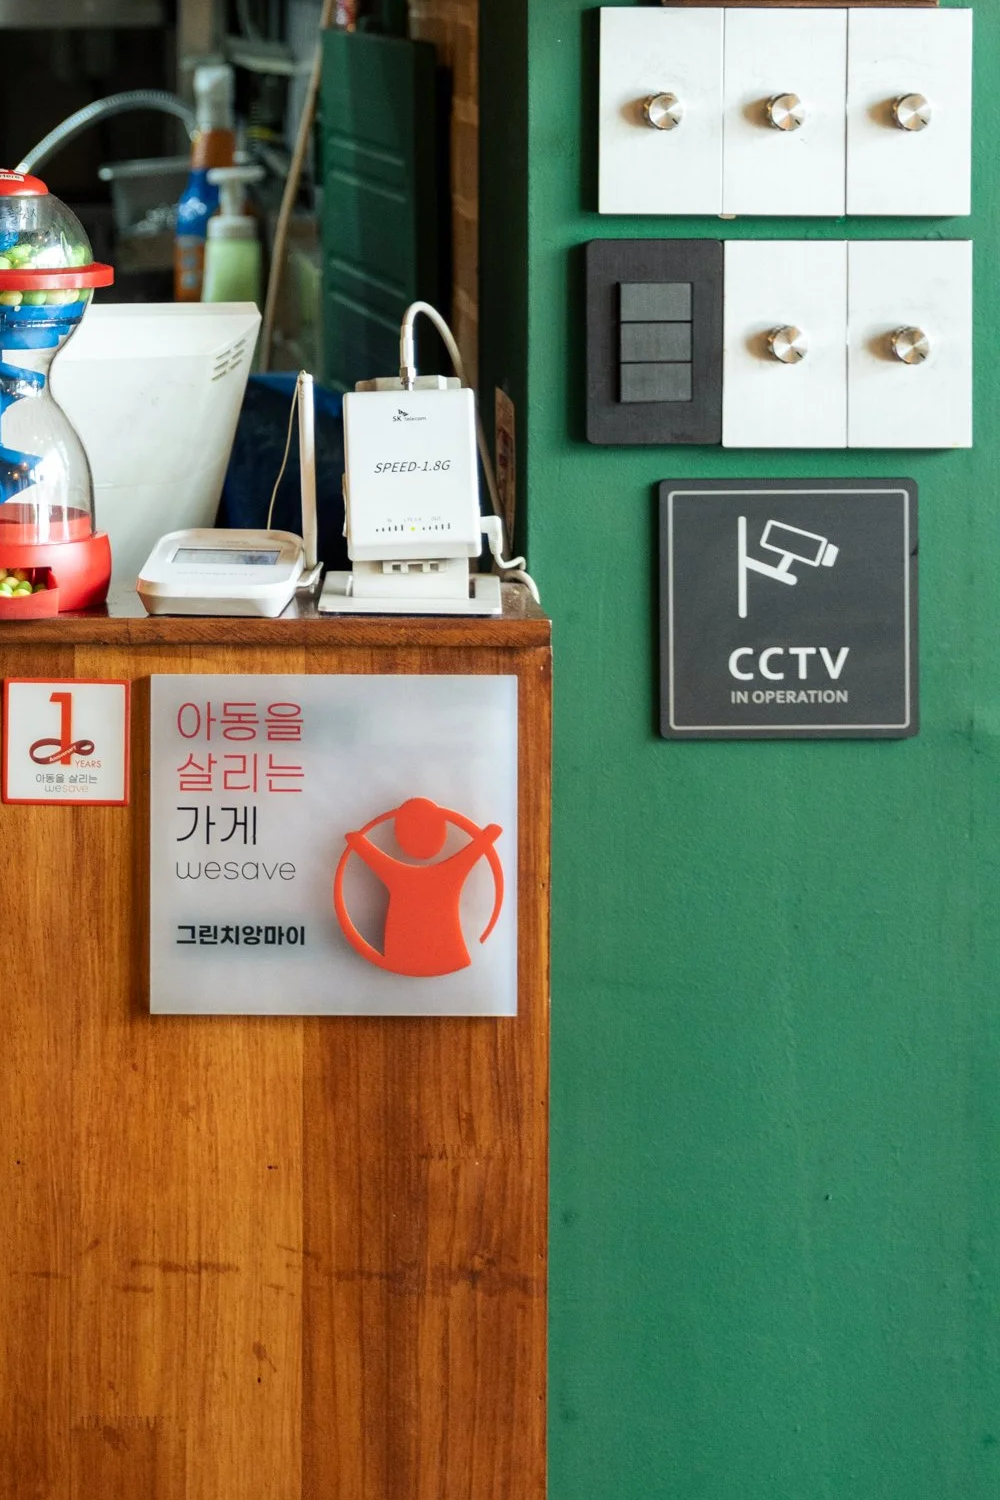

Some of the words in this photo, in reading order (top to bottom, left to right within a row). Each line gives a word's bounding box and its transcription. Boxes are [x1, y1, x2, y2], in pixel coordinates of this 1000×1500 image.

[374, 460, 451, 473] SPEED-1.8G
[728, 647, 849, 680] CCTV
[731, 690, 748, 704] IN
[752, 690, 848, 703] OPERATION
[177, 701, 304, 741] 아동을
[75, 760, 102, 768] YEARS
[176, 753, 304, 793] 살리는
[35, 773, 65, 783] 아동을
[68, 774, 98, 784] 살리는
[44, 784, 88, 792] wesave
[176, 806, 257, 845] 가게
[175, 861, 296, 881] wesave
[176, 924, 305, 946] 그린치앙마이
